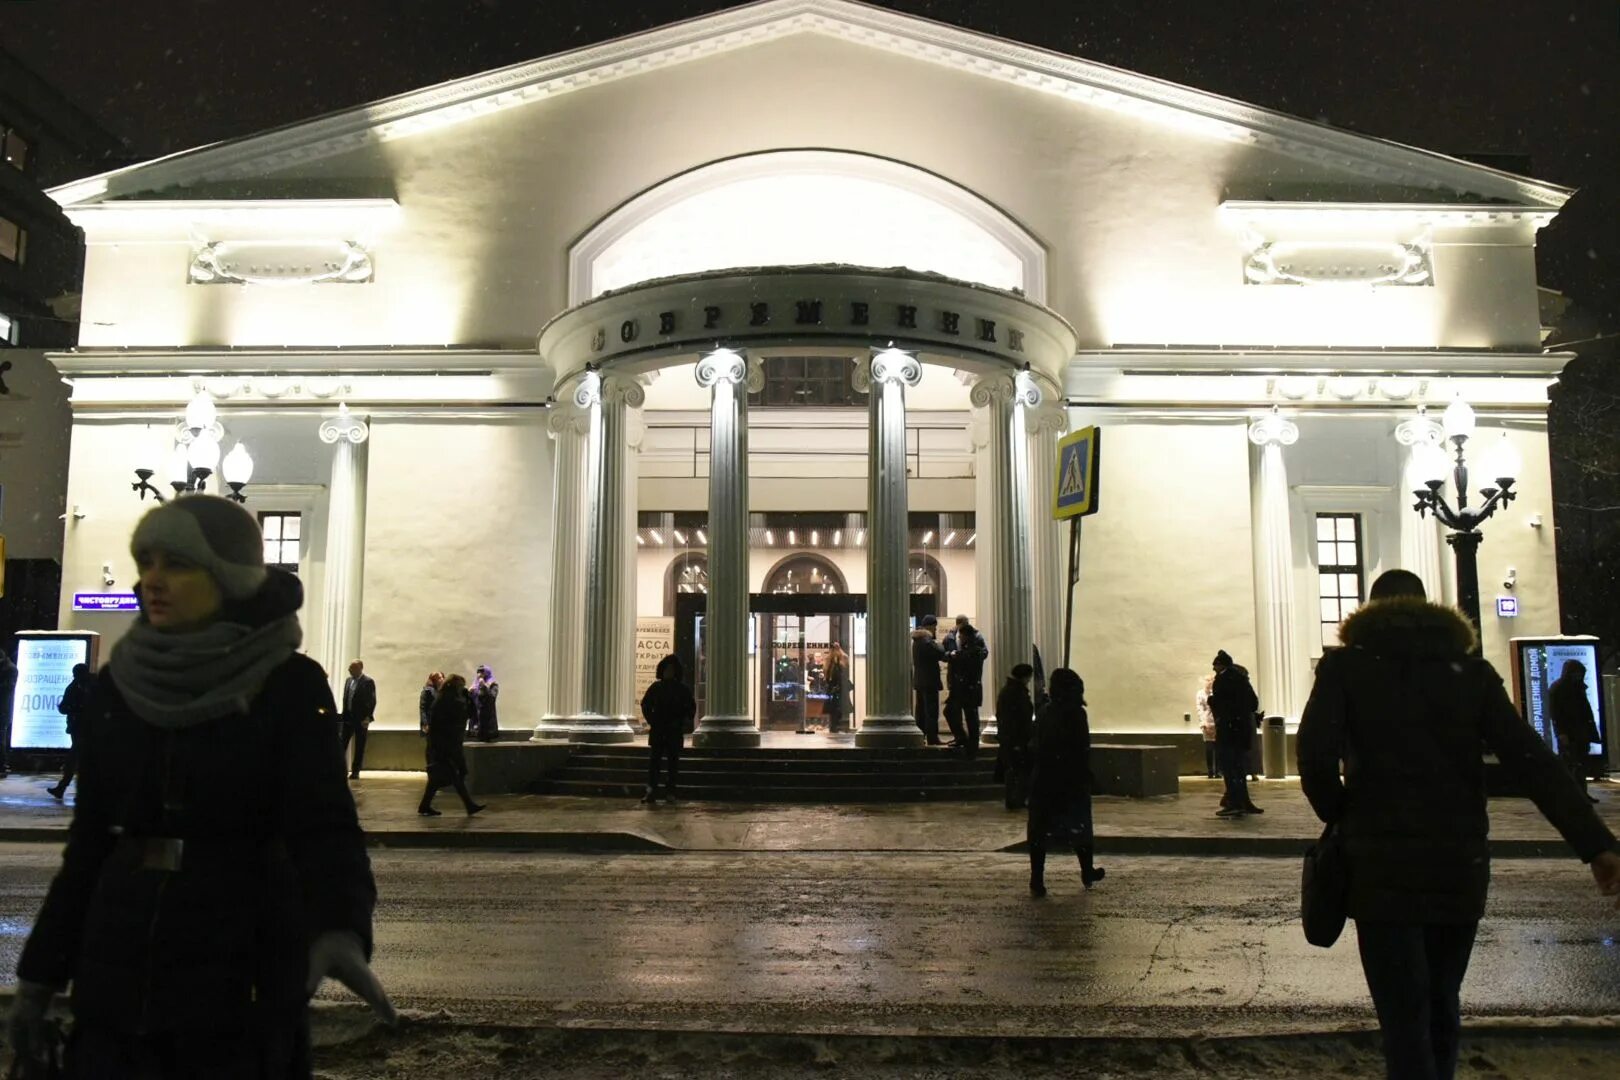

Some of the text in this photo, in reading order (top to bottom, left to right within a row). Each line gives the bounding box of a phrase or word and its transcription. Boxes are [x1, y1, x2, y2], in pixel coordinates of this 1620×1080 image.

[591, 299, 1024, 353] СОВРЕМЕННИК
[1502, 601, 1515, 610] 19
[637, 640, 670, 650] АССА
[1527, 648, 1541, 678] ДОМОЙ
